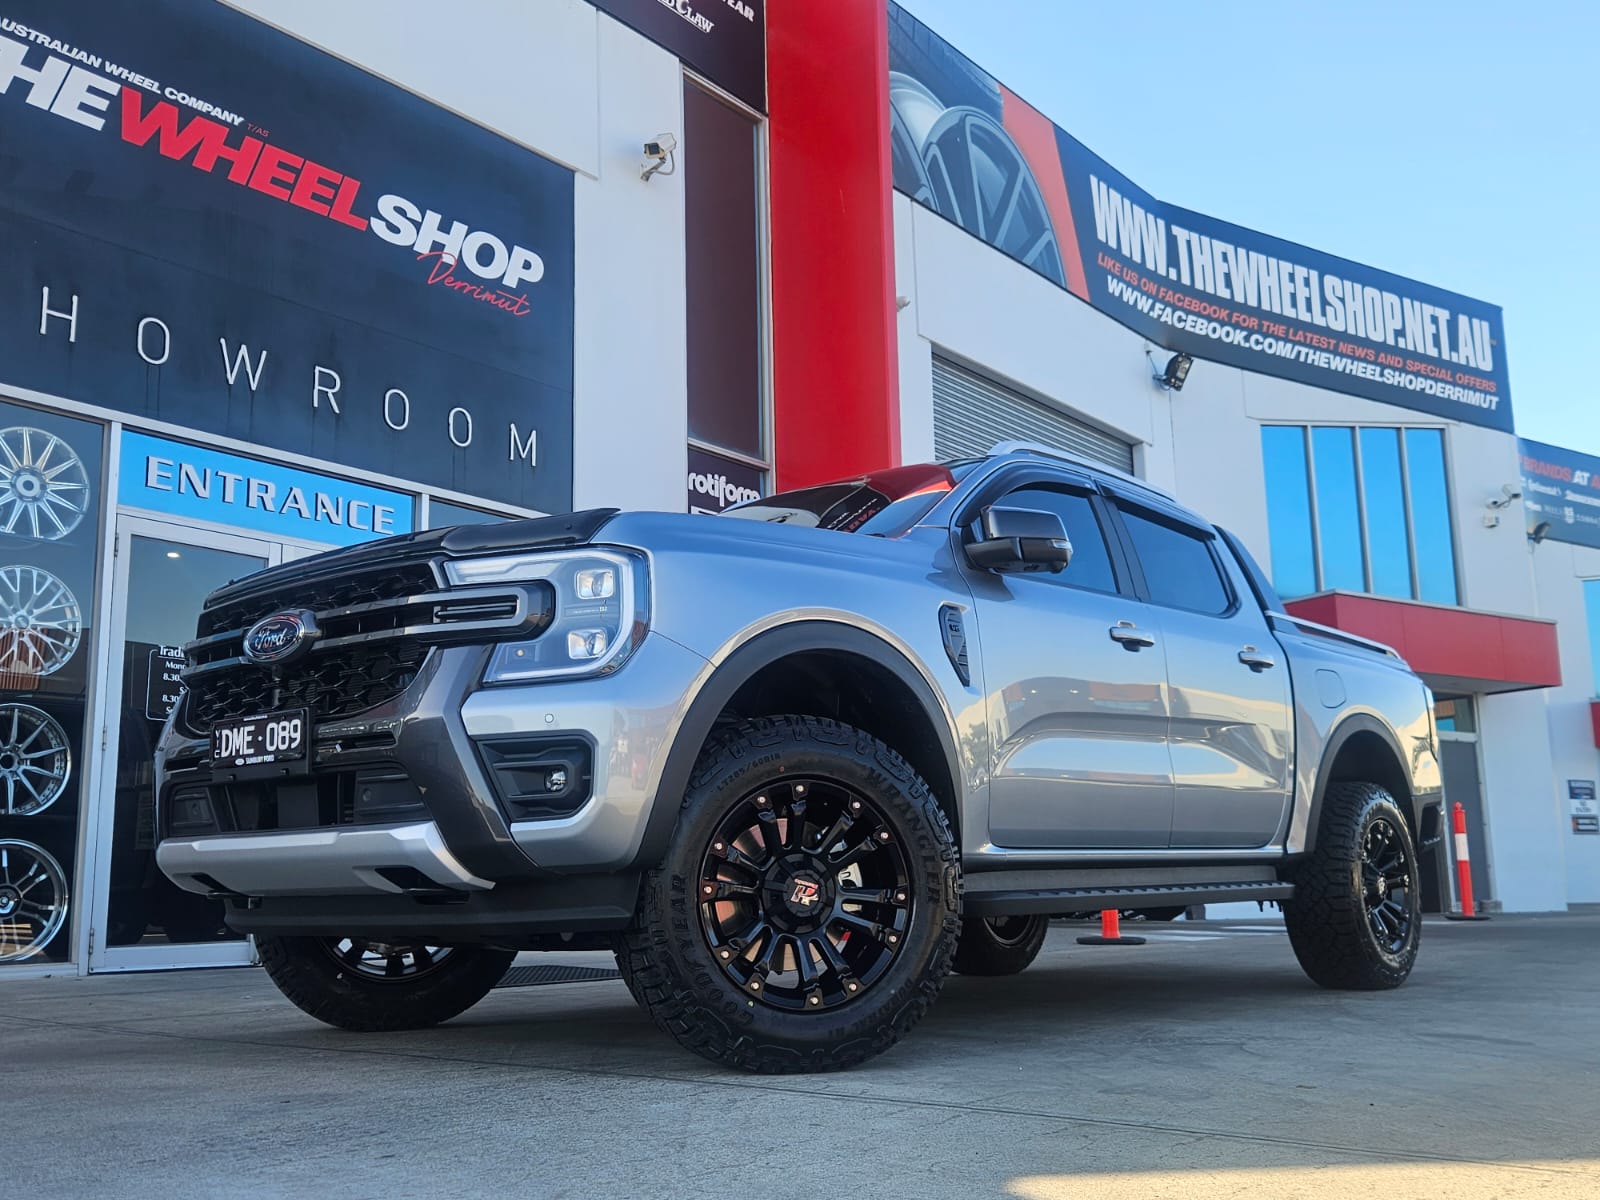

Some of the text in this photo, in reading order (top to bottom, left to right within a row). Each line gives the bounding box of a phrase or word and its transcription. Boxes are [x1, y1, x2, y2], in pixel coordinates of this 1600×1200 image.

[0, 17, 102, 68] USTRALIAN
[105, 61, 161, 94] WHEEL
[164, 87, 245, 126] COMPANY
[417, 252, 530, 316] Derrimut
[1090, 174, 1494, 372] WWW.THEWHEELSHOP.NET.AU
[1098, 252, 1497, 392] LIKE US ON FACEBOOK FOR THE LATEST NEWS AND SPECIAL OFFERS
[1107, 274, 1499, 410] WWW.FACEBOOK.COM/THEWHEELSHOPDERRIMUT
[145, 455, 395, 536] ENTRANCE
[688, 472, 761, 507] rotiform
[1573, 470, 1590, 486] AT
[254, 625, 288, 651] Ford
